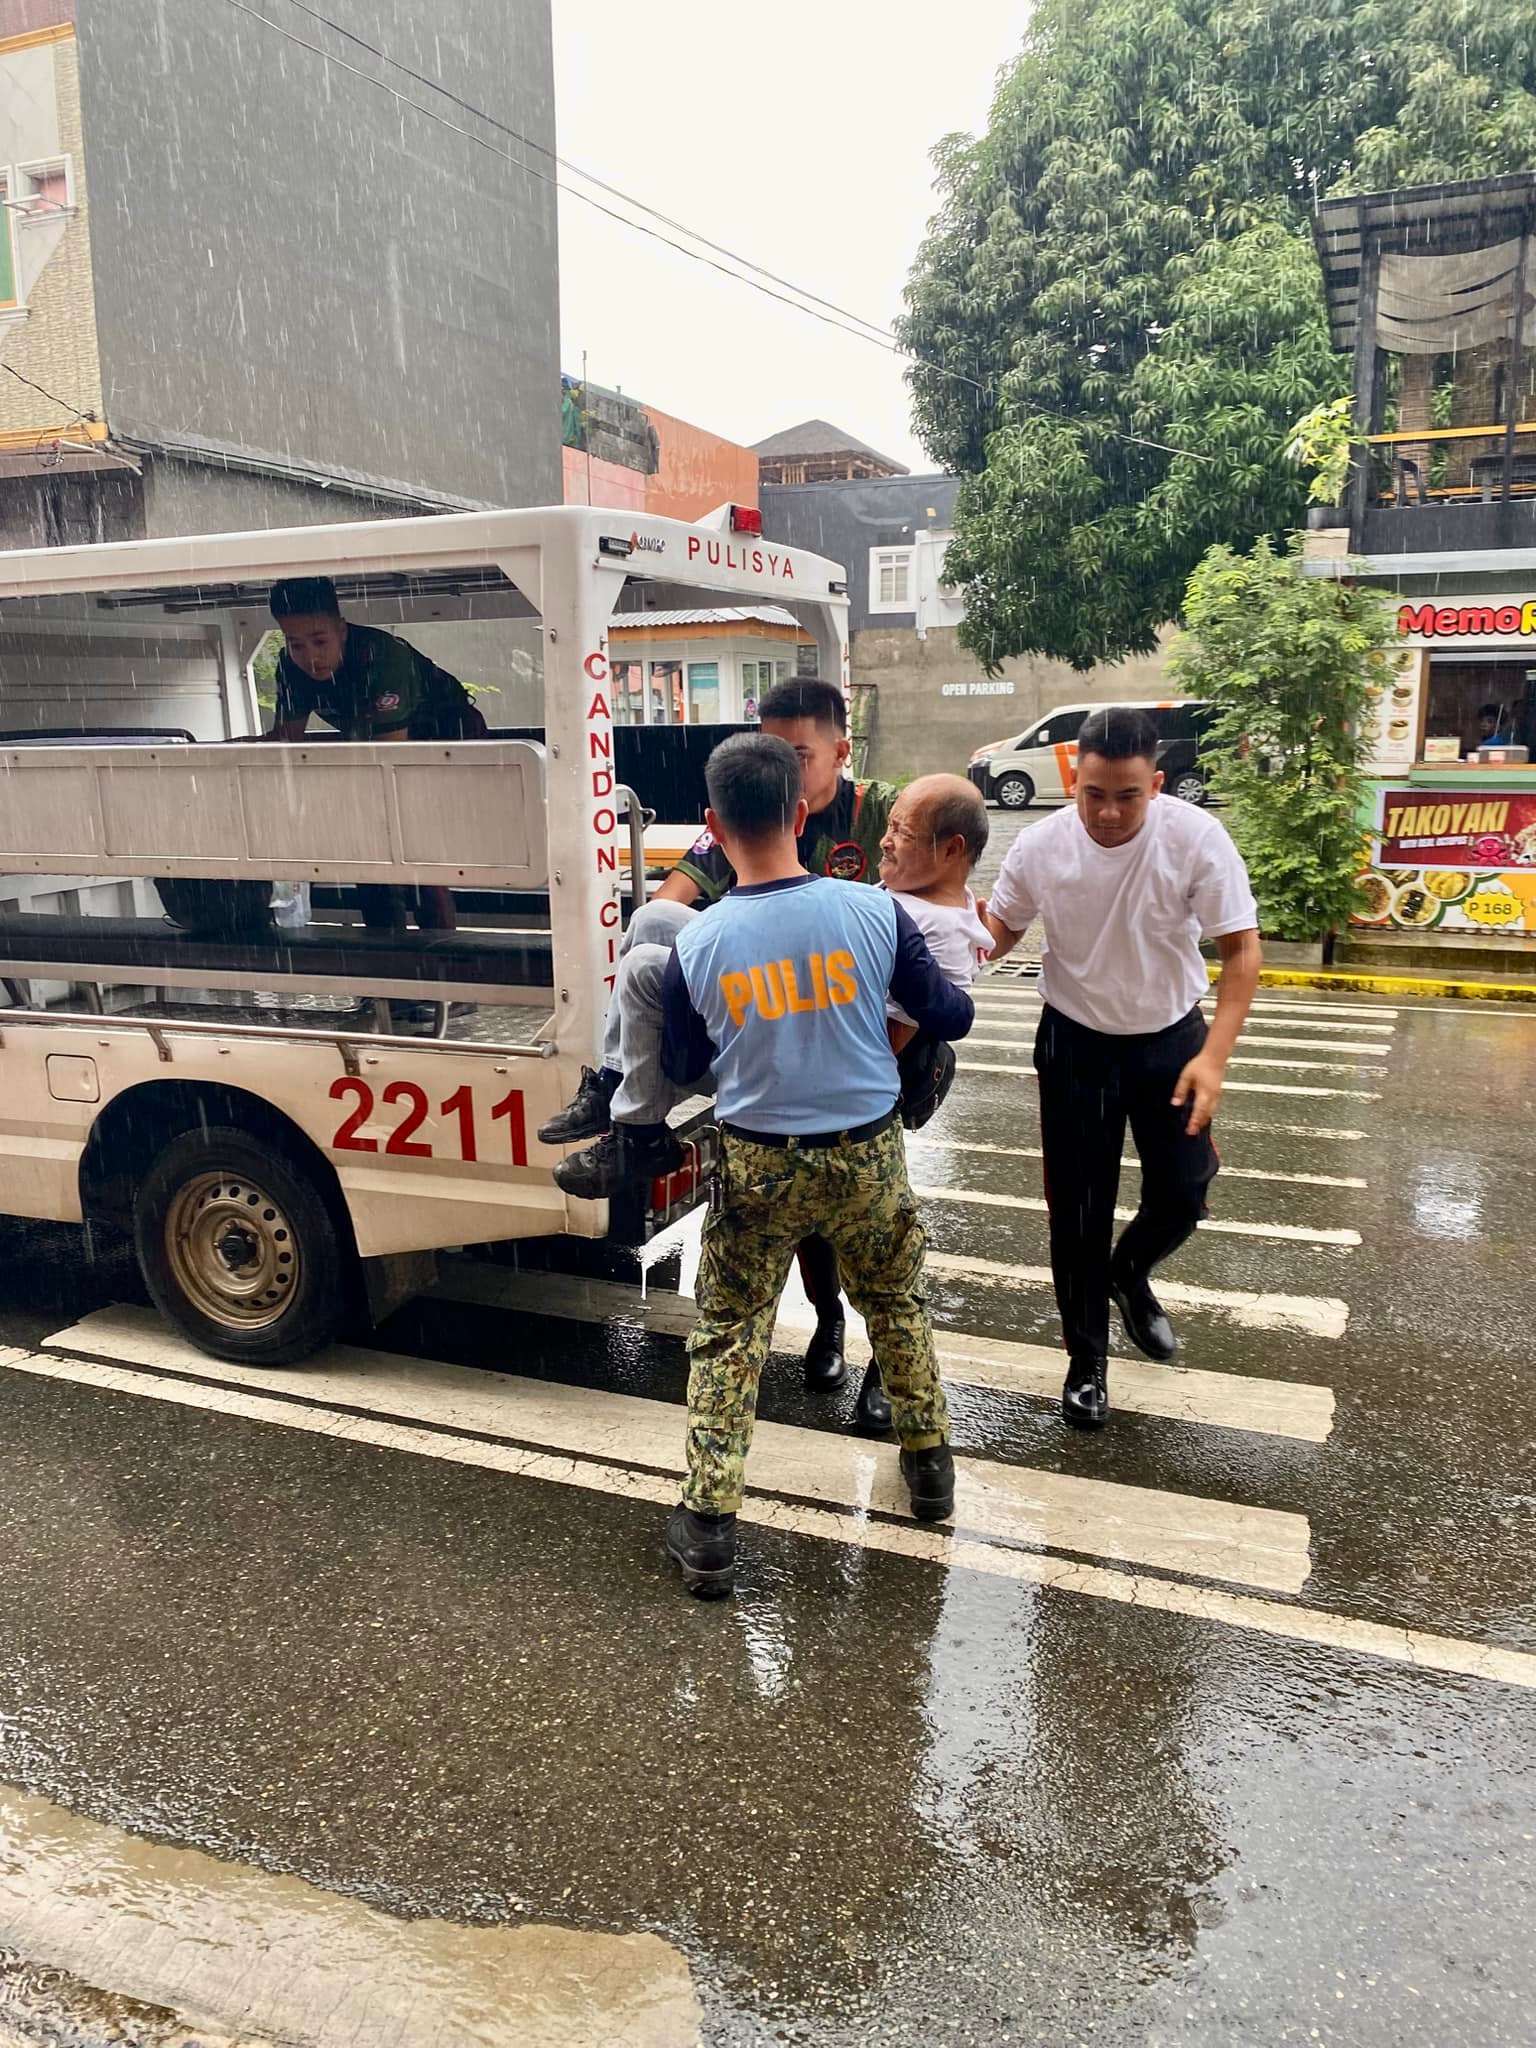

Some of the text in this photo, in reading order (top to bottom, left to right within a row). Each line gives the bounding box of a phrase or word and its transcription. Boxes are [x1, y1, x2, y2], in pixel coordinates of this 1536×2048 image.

[687, 536, 795, 580] PULISYA
[942, 681, 1016, 696] OPEN PARKING
[583, 652, 617, 874] CANDON
[1386, 800, 1511, 838] TAKOYAKI
[1483, 903, 1512, 915] 168
[719, 949, 859, 1028] PULIS
[328, 1076, 528, 1168] 2211
